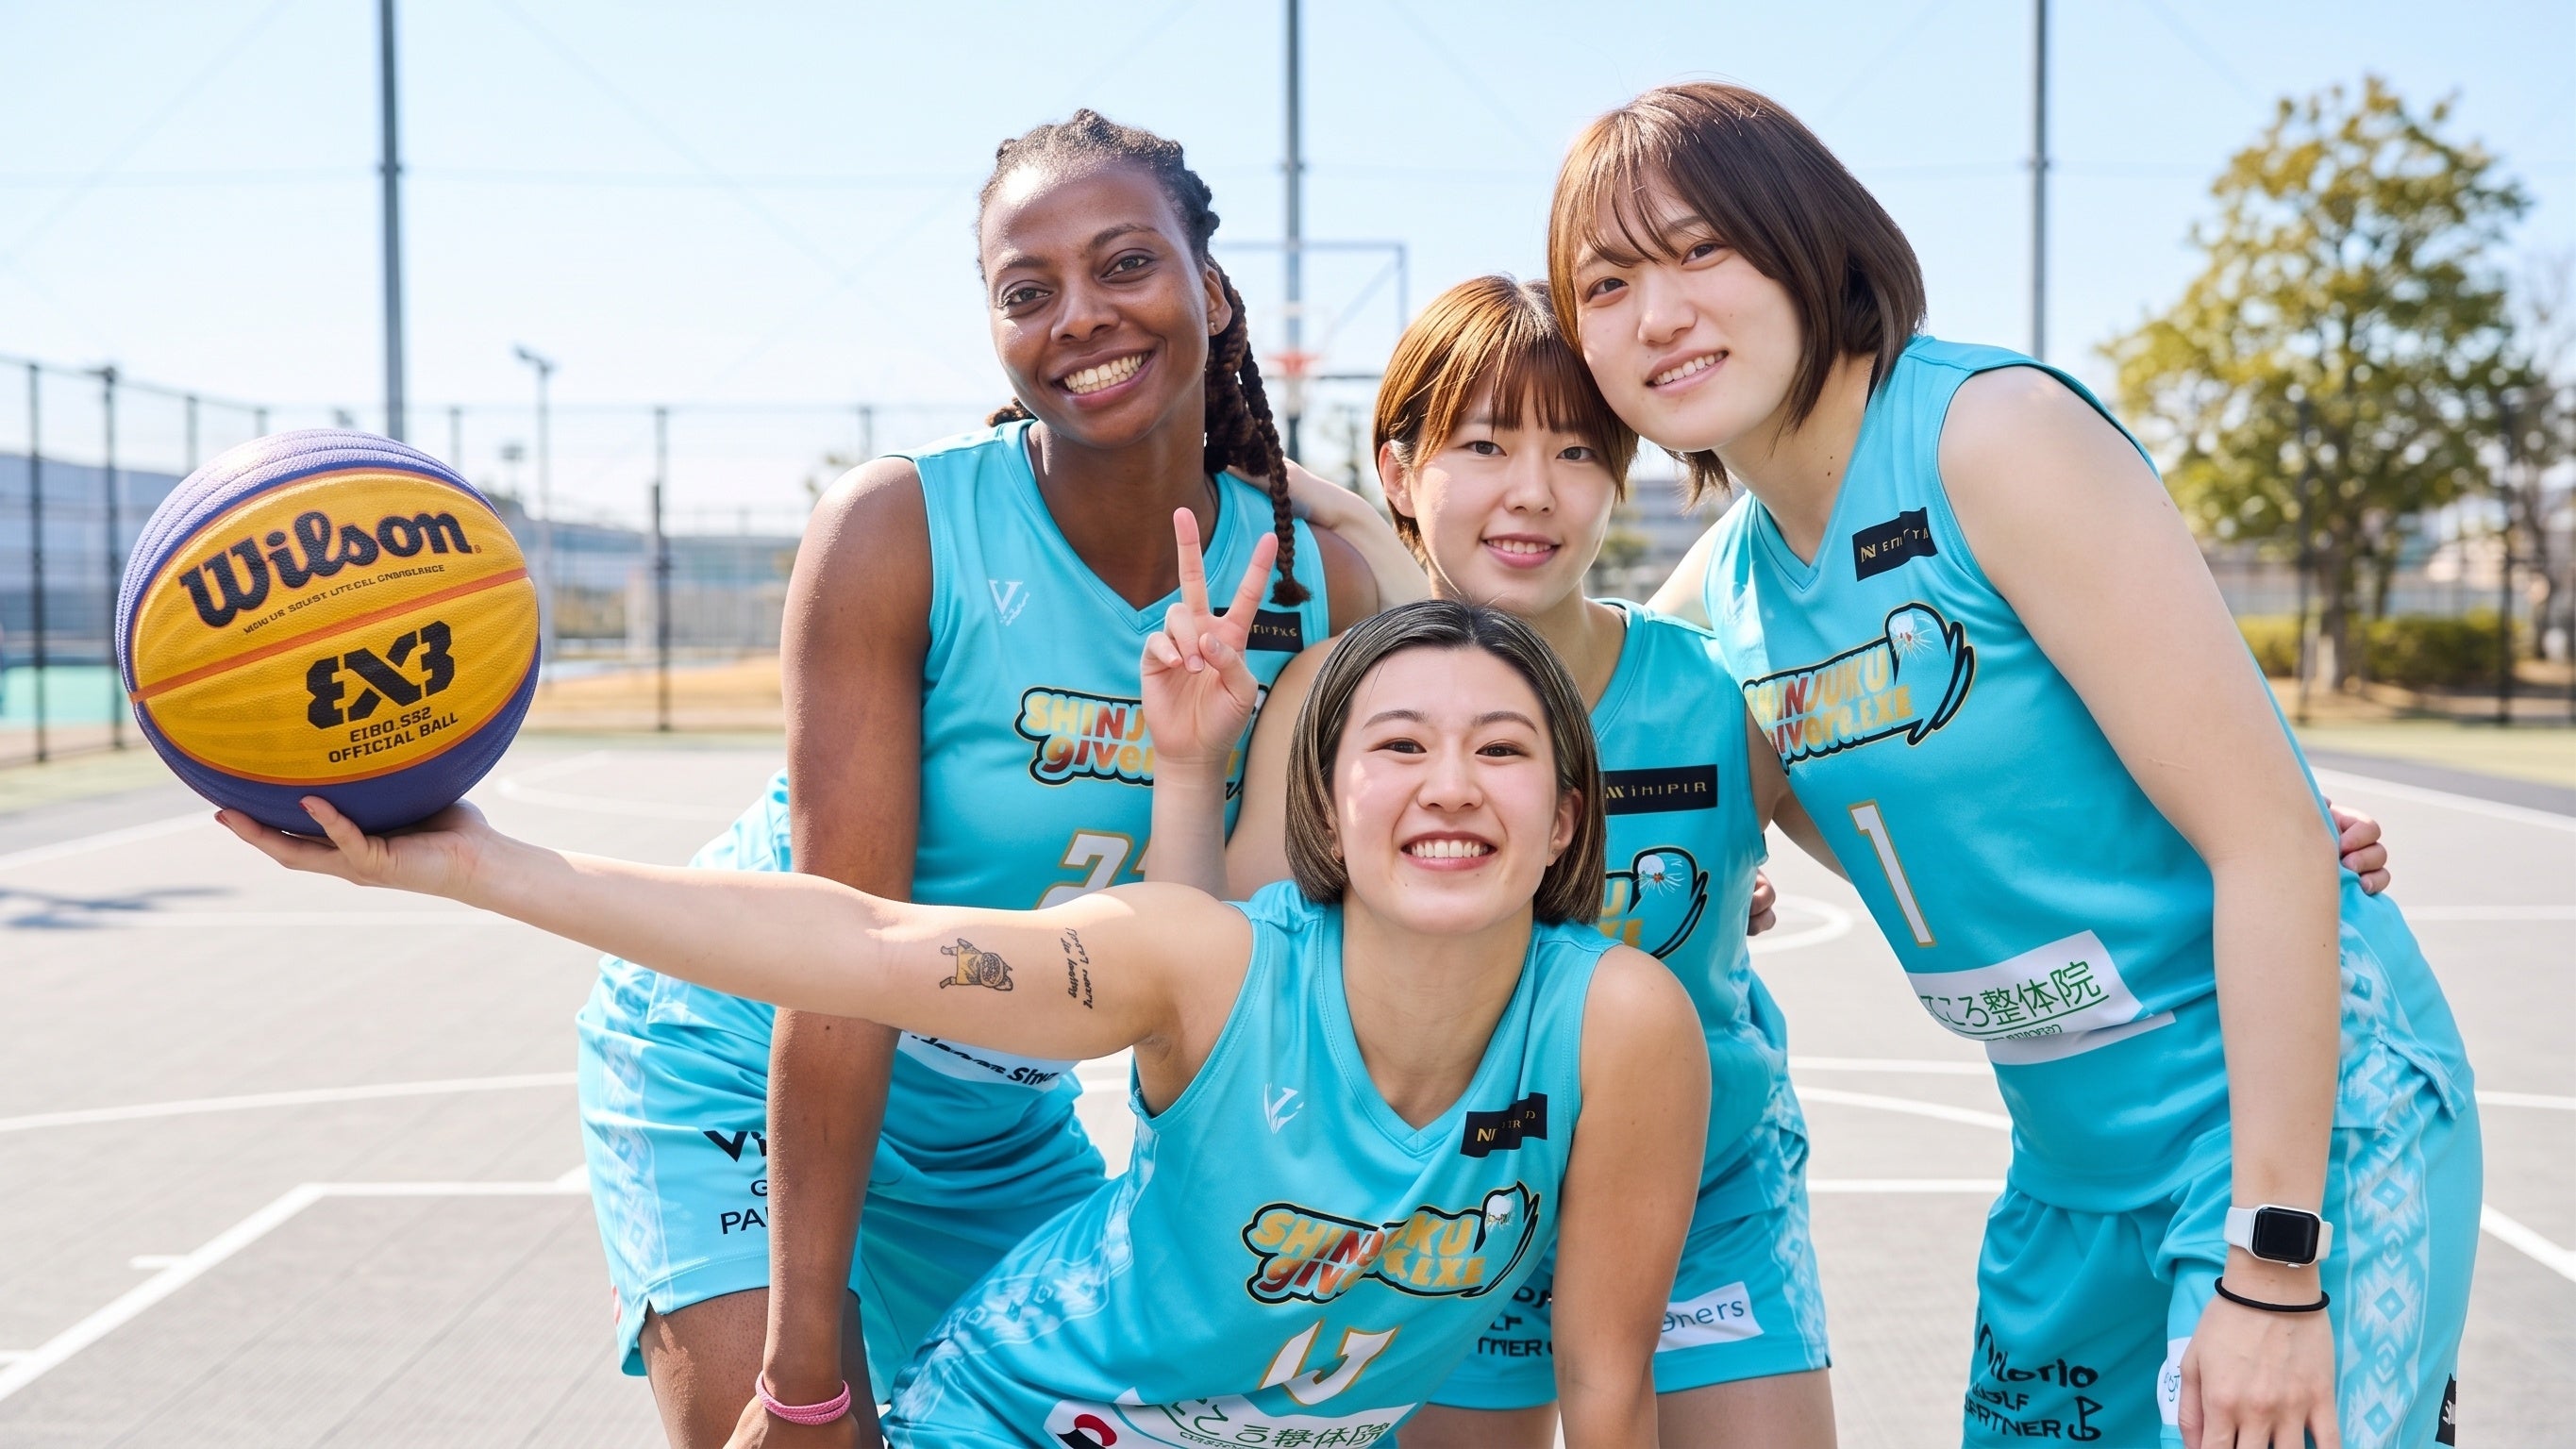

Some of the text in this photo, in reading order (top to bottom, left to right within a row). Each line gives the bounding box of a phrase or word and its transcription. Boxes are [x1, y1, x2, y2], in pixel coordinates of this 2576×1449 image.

[179, 510, 473, 628] Wilson
[328, 712, 459, 763] OFFICIAL BALL
[1027, 695, 1146, 741] SHINJ
[1848, 800, 1936, 947] 1
